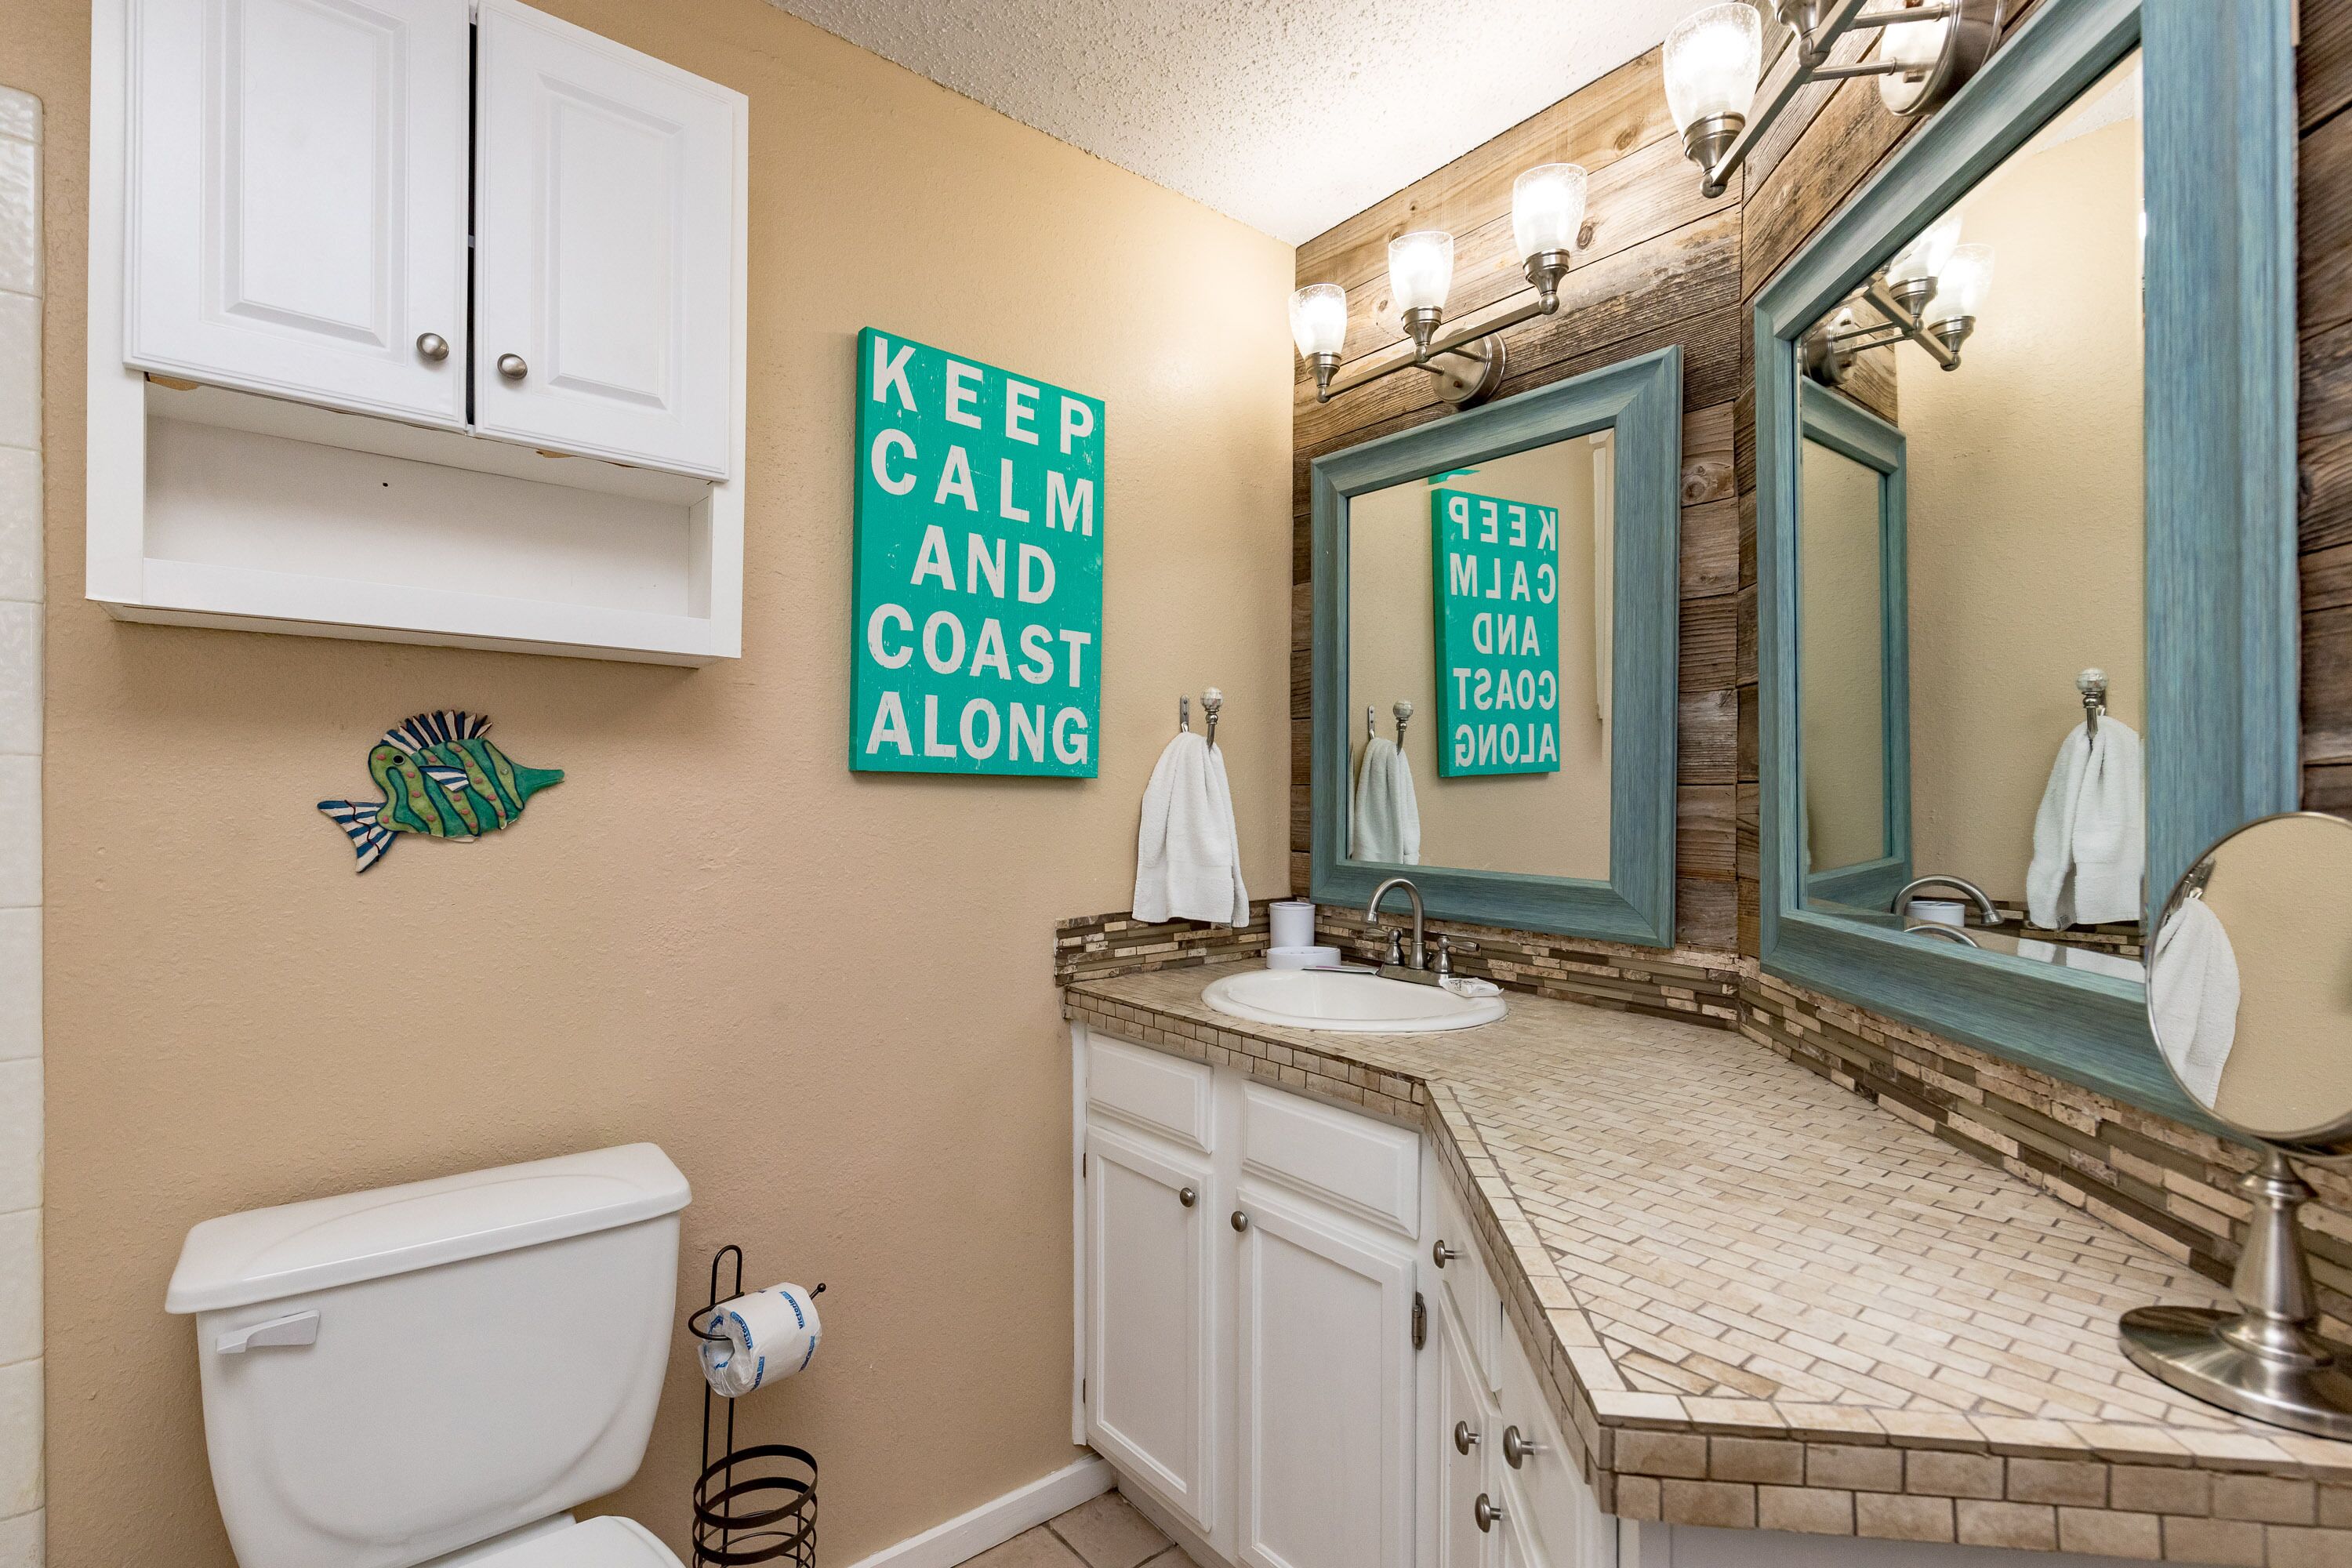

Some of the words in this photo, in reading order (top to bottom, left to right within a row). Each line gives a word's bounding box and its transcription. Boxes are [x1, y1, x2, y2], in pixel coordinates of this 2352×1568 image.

[873, 336, 1094, 456] KEEP
[871, 428, 1094, 537] CALM
[910, 524, 1055, 604] AND
[867, 603, 1091, 688] COAST
[866, 691, 1089, 764] ALONG
